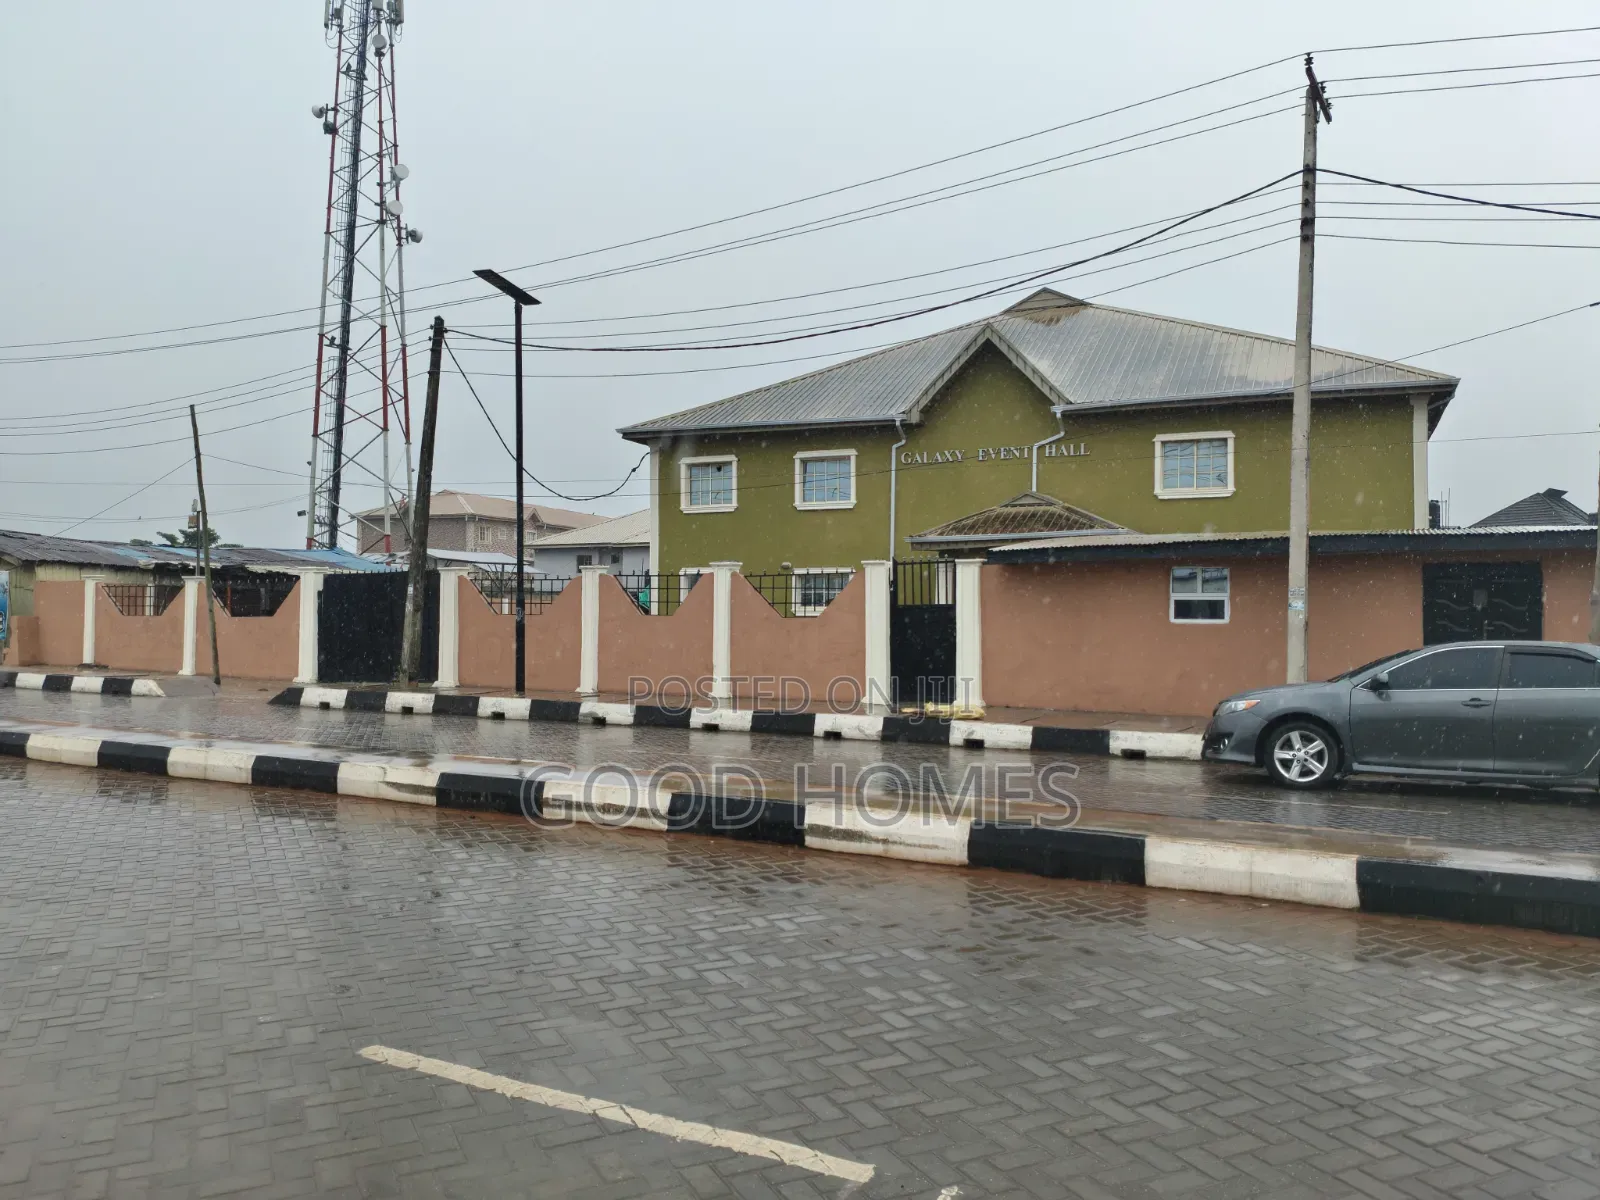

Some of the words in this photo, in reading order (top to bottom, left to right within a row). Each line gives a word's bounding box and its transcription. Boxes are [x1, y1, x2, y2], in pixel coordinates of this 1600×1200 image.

[901, 449, 965, 464] GALAXY
[978, 446, 1031, 461] EVENT
[1045, 443, 1090, 458] HALL
